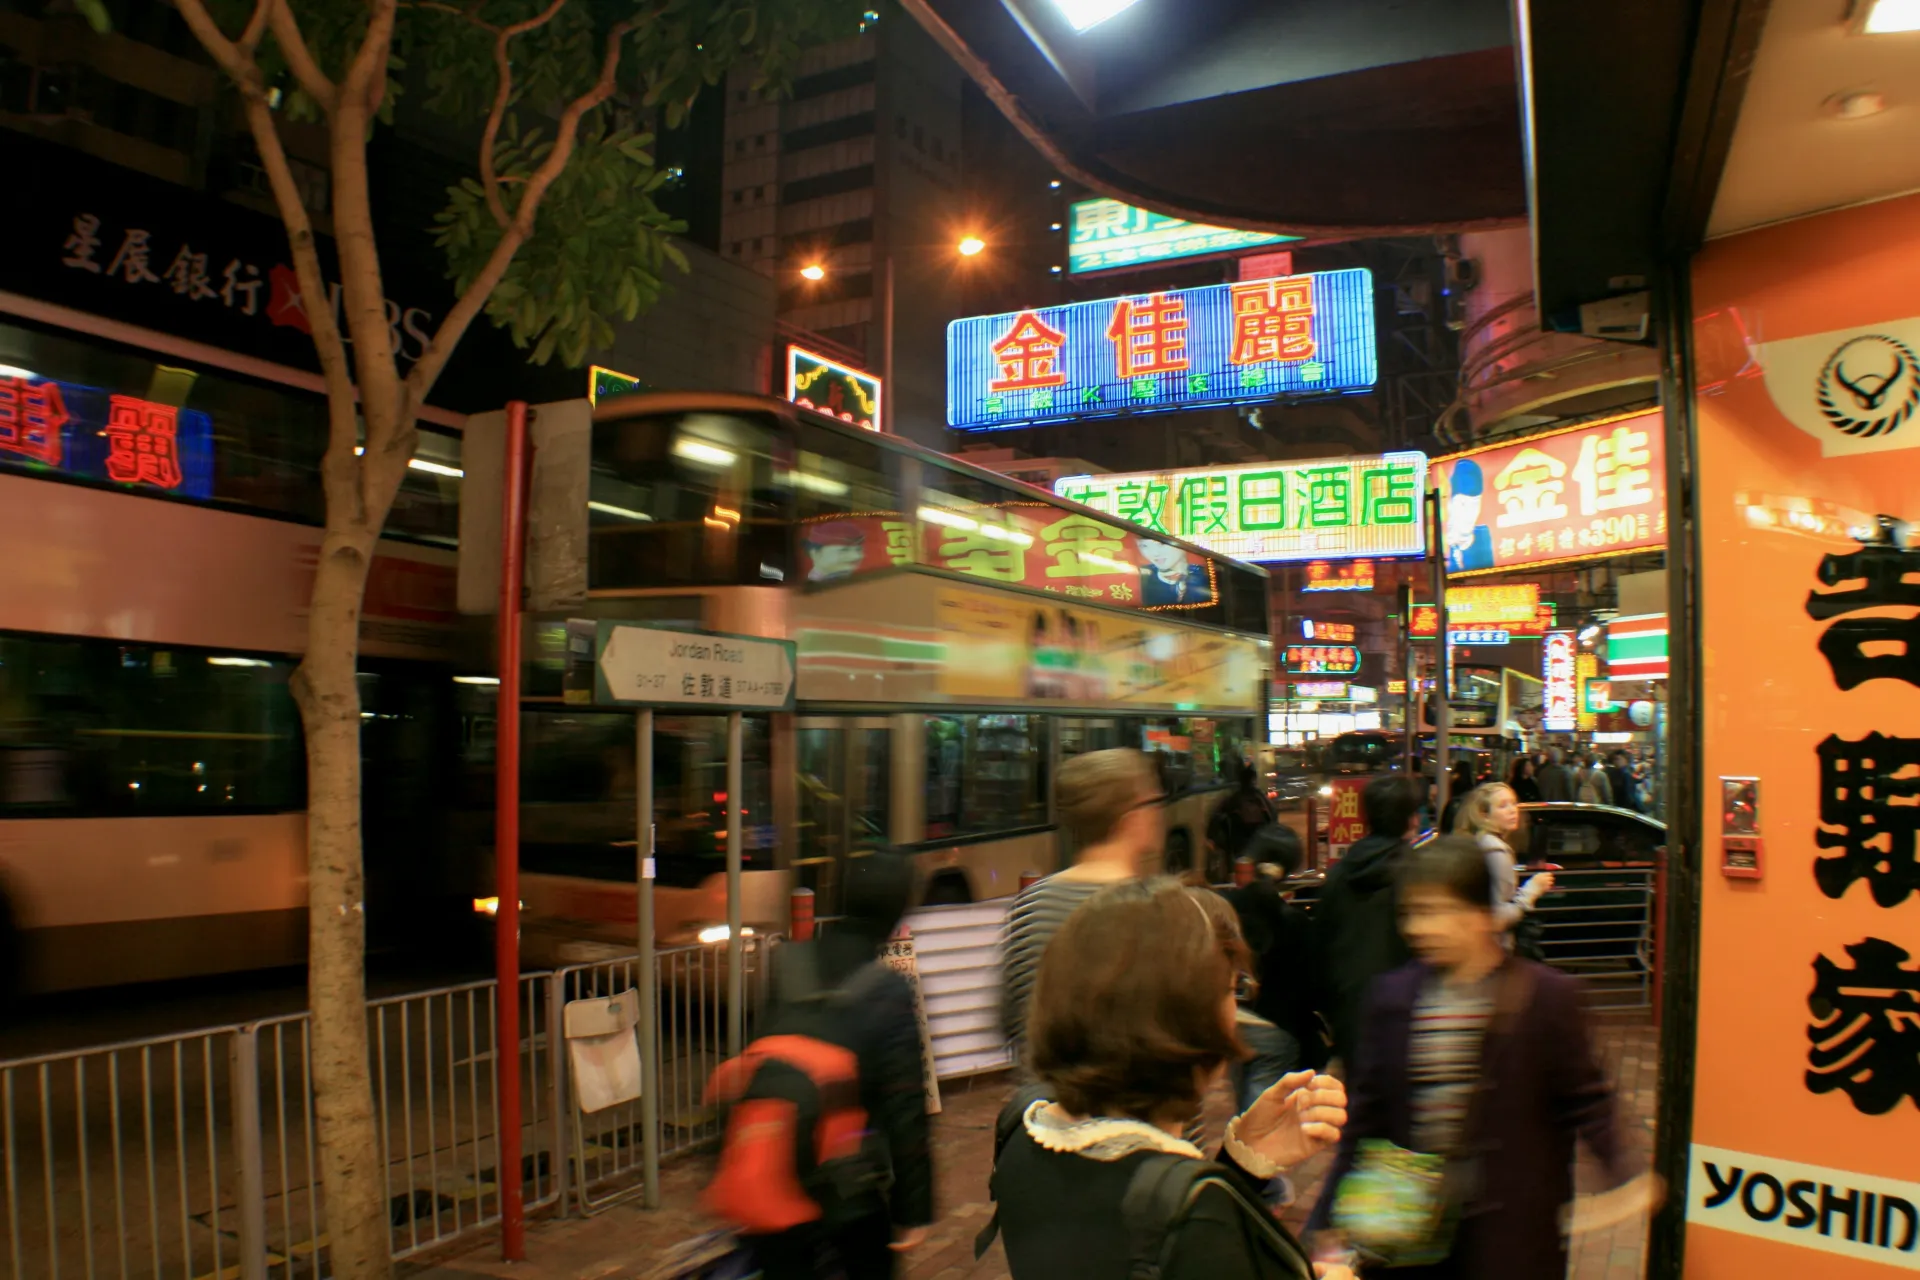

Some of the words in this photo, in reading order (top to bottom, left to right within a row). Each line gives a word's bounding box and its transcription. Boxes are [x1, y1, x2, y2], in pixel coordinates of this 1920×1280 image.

[61, 212, 265, 317] 星展銀行
[327, 282, 434, 363] BS
[988, 275, 1320, 393] 金佳麗
[1493, 426, 1655, 529] 金佳
[669, 638, 711, 660] Jordan
[713, 643, 745, 664] Road
[682, 673, 732, 699] 佐敦道
